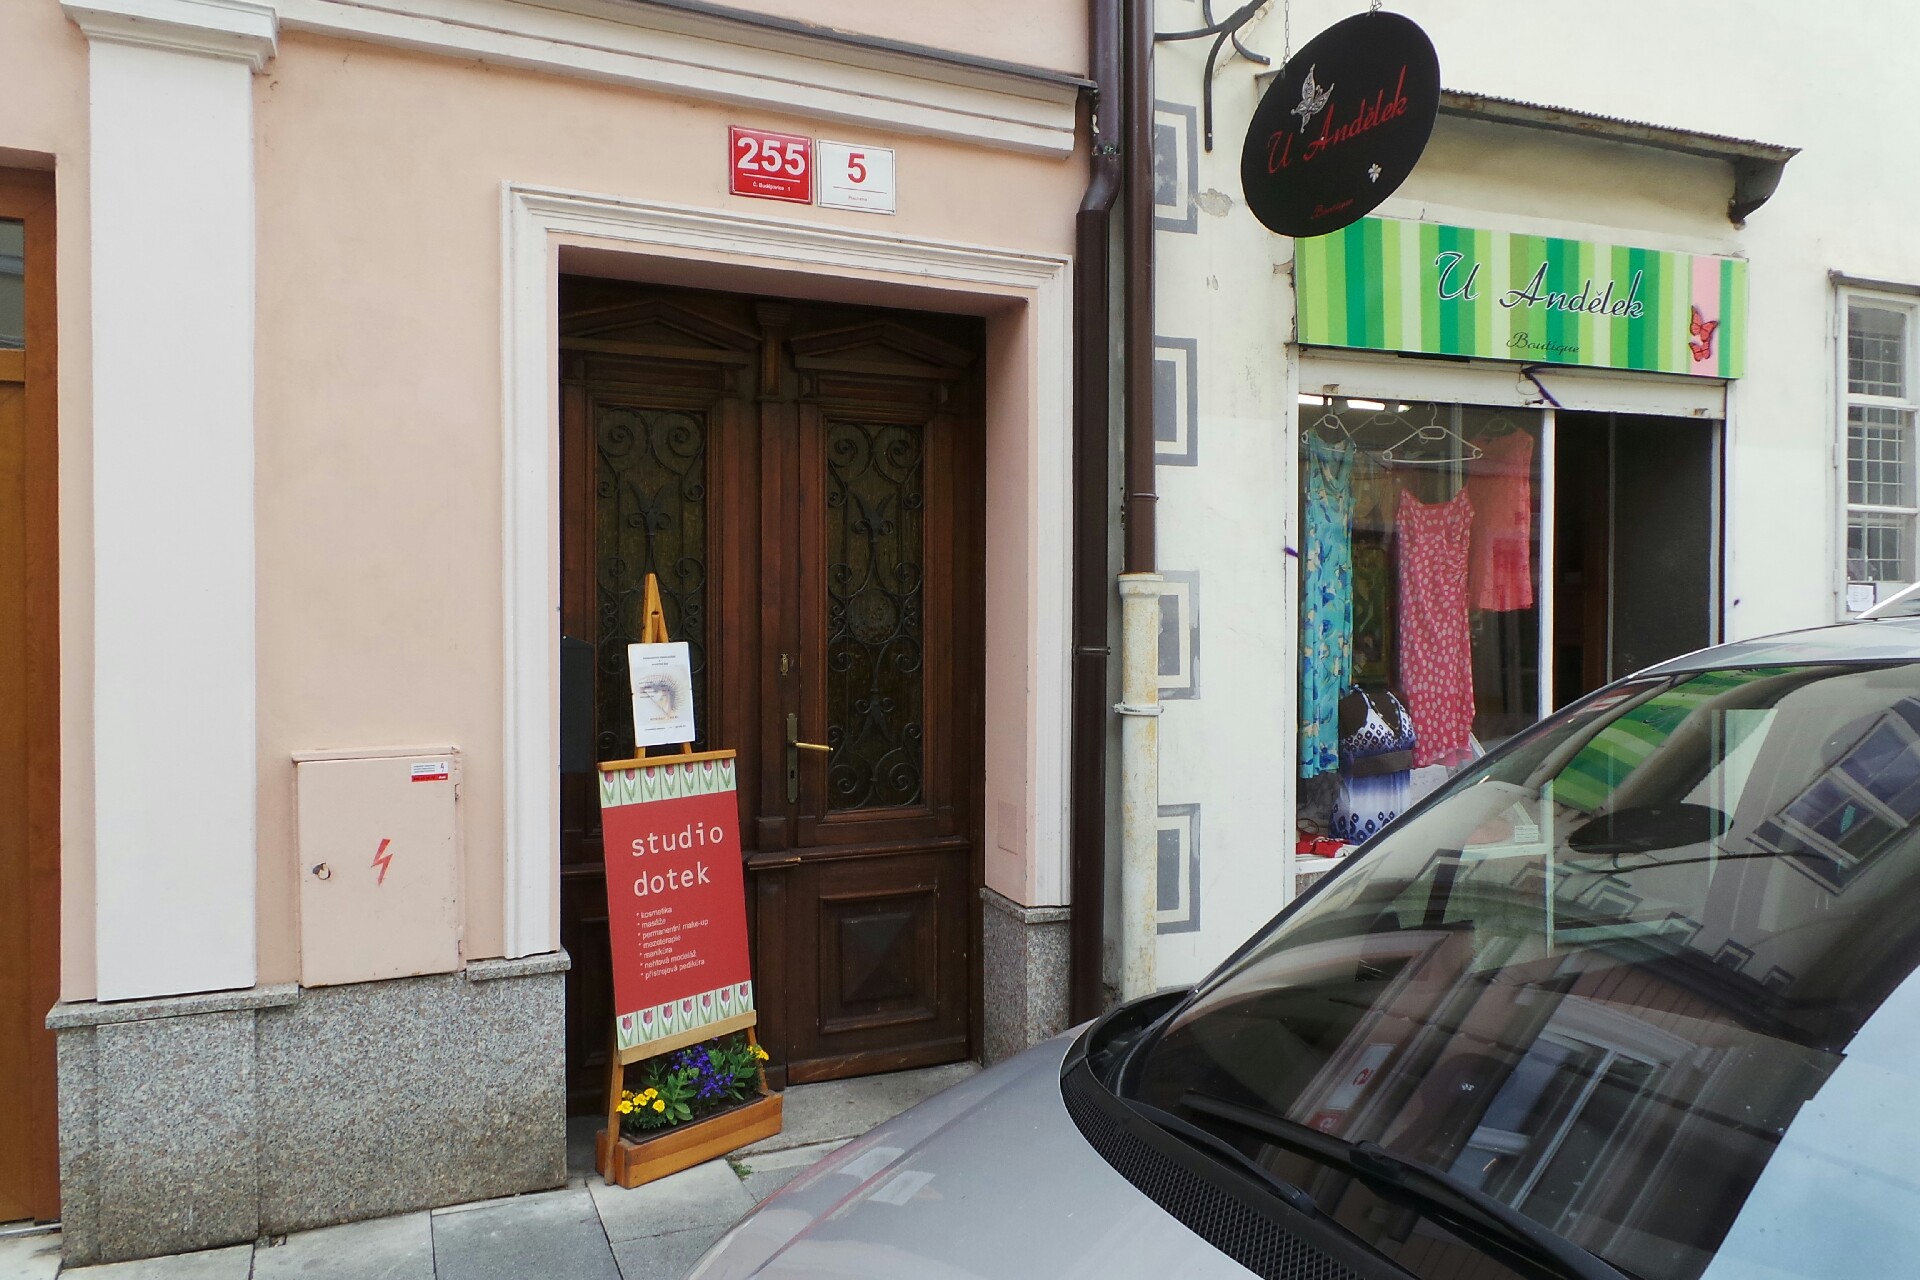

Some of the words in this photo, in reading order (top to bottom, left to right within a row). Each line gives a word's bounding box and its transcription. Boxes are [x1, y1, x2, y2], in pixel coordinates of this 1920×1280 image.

[1267, 130, 1294, 175] U
[1303, 63, 1409, 161] Andělek
[737, 137, 806, 176] 255
[847, 153, 867, 184] 5
[1434, 251, 1482, 301] U
[1498, 261, 1645, 319] Andělek
[1506, 331, 1580, 355] Boutique
[631, 822, 724, 857] studio
[633, 861, 711, 897] dotek
[640, 906, 673, 919] kosmetika
[641, 917, 667, 929] masáže
[642, 924, 681, 941] permanentní
[682, 919, 709, 930] make-up
[643, 935, 681, 949] mezoterapie
[644, 957, 670, 969] nehtová
